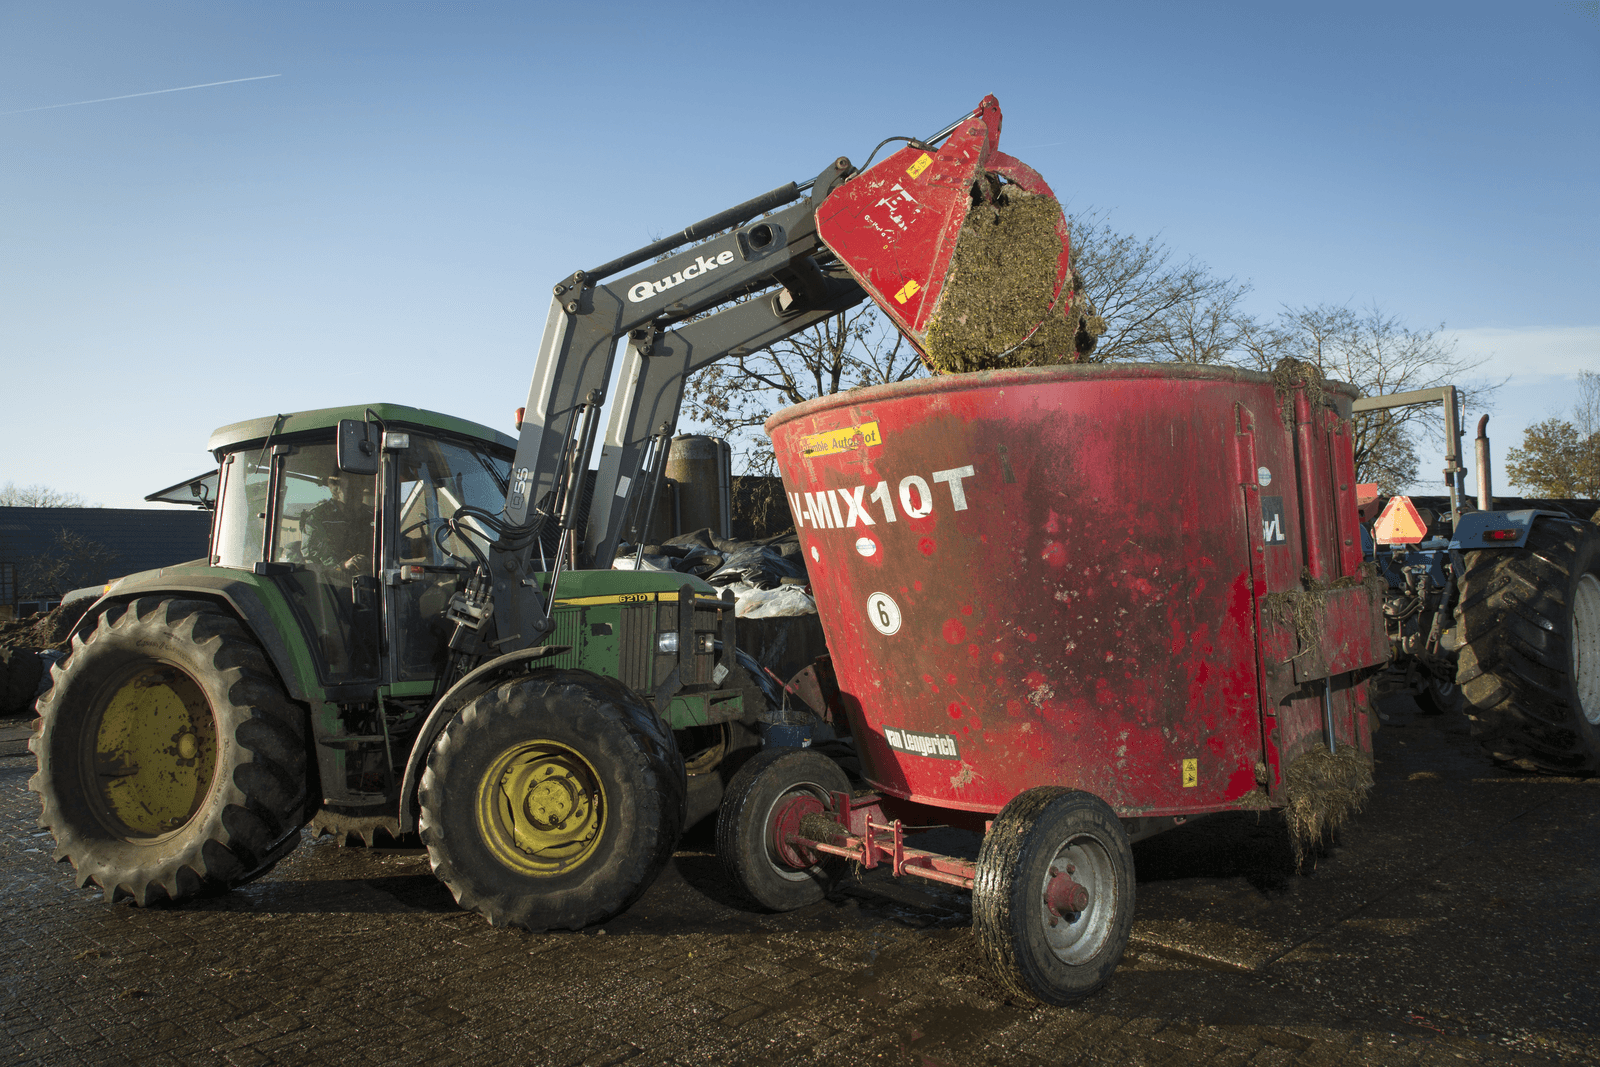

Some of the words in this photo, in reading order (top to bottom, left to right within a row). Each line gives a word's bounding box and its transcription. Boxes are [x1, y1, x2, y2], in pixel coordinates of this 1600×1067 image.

[627, 250, 735, 303] Quicke
[618, 593, 648, 603] 6210
[876, 600, 890, 627] 6
[884, 728, 904, 749] van
[901, 729, 957, 757] Lengerich
